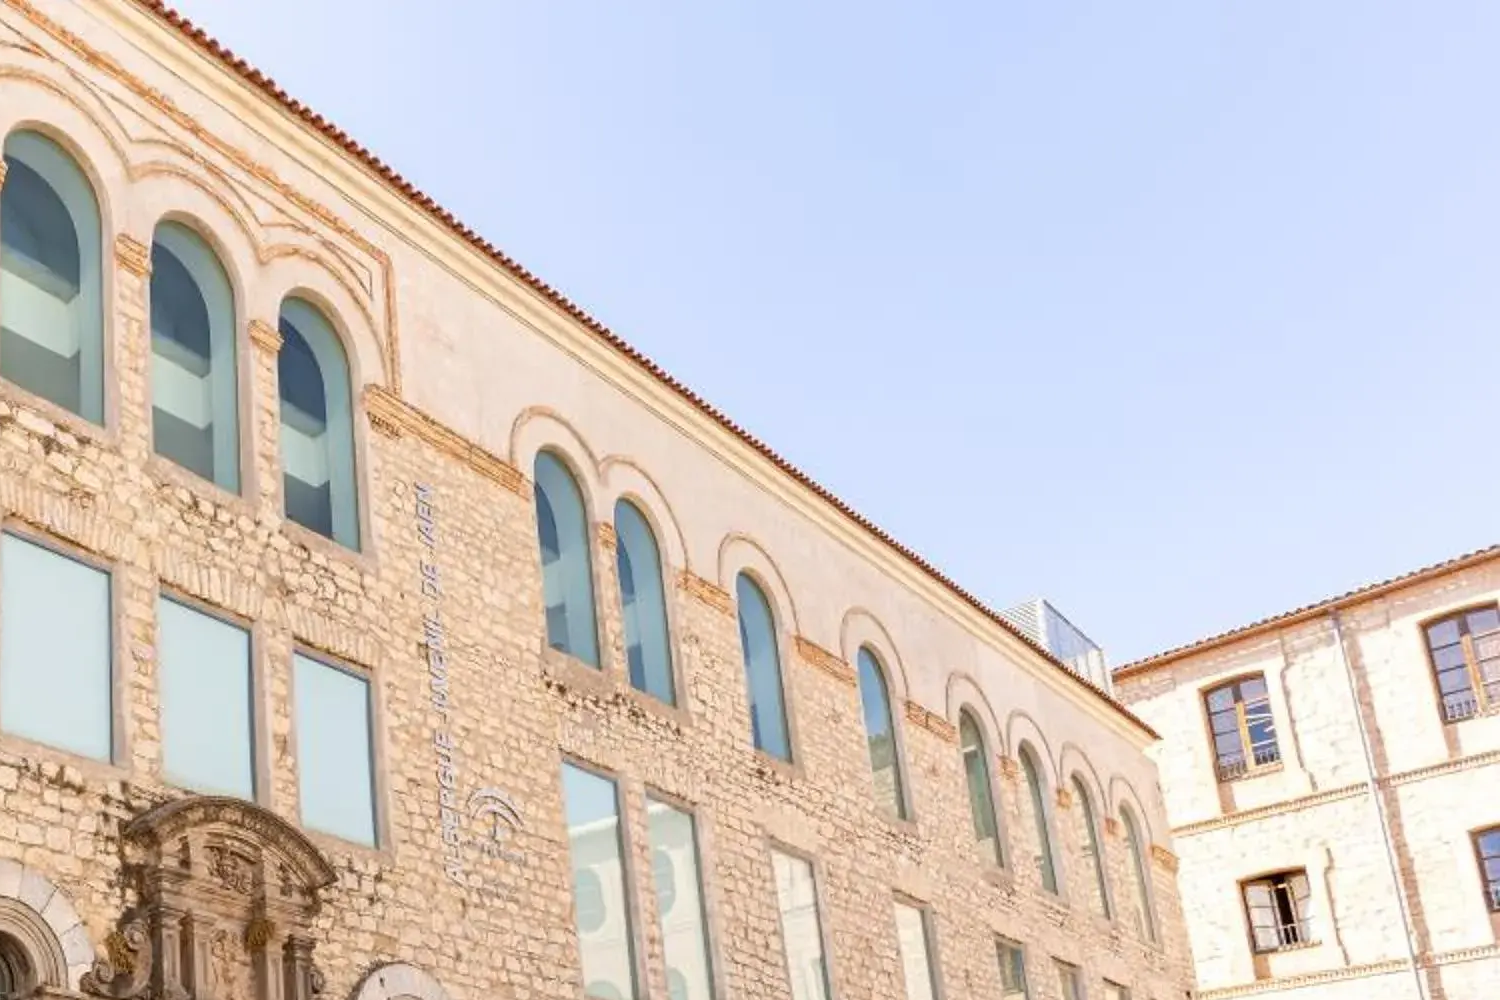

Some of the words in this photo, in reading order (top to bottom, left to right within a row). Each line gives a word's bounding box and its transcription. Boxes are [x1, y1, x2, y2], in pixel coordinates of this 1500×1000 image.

[420, 559, 444, 600] DE
[422, 607, 449, 724] JUVENIL
[434, 729, 468, 888] ALBERGUE
